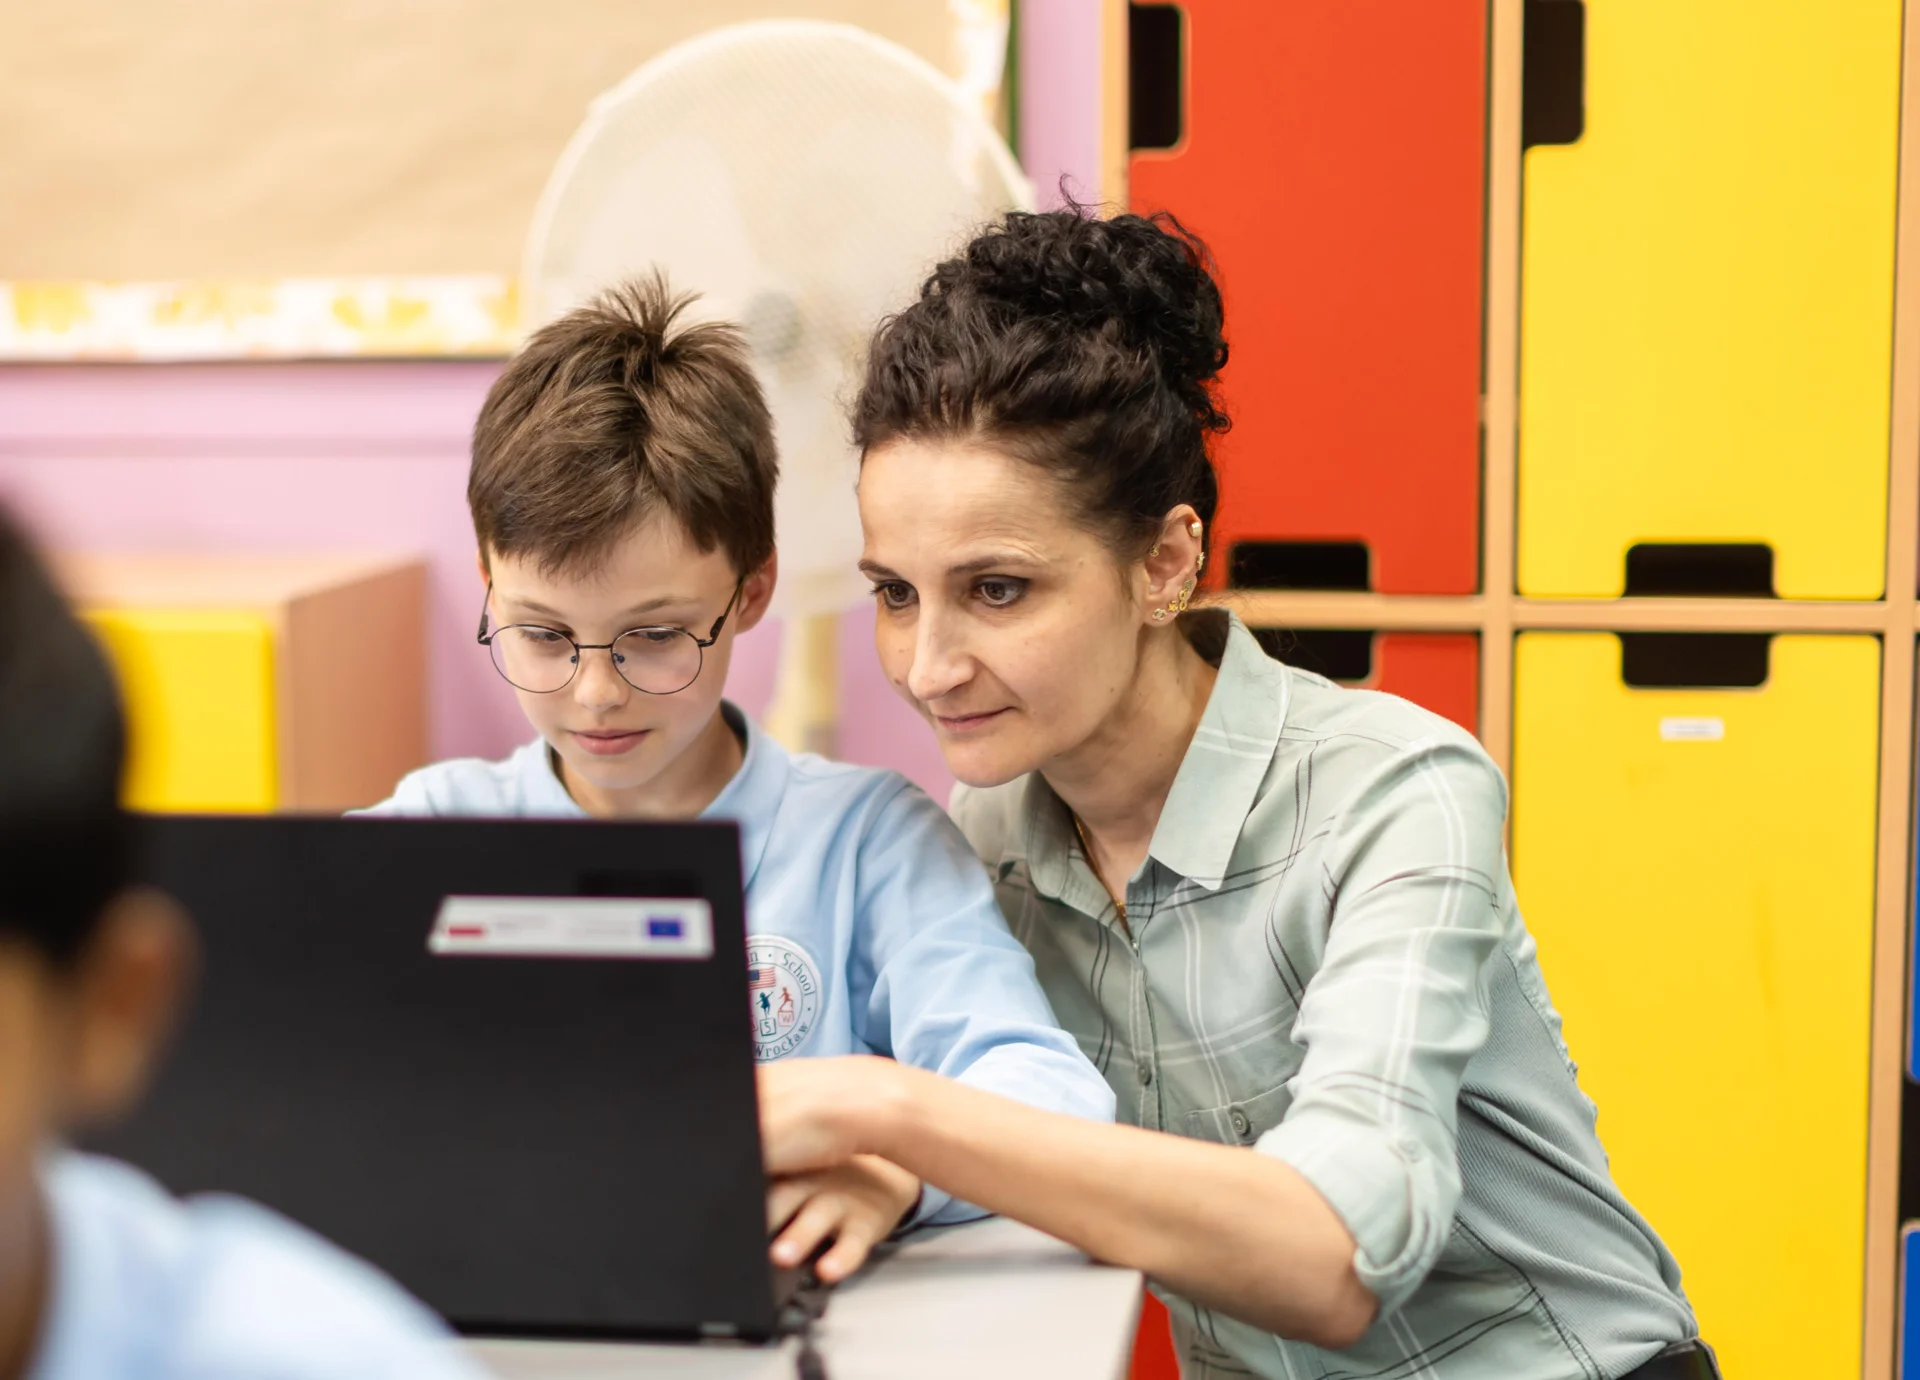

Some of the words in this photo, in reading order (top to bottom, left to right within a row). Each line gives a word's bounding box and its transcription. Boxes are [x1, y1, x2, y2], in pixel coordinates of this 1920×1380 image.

[782, 952, 816, 996] School
[763, 1021, 772, 1034] S
[781, 1014, 791, 1023] W
